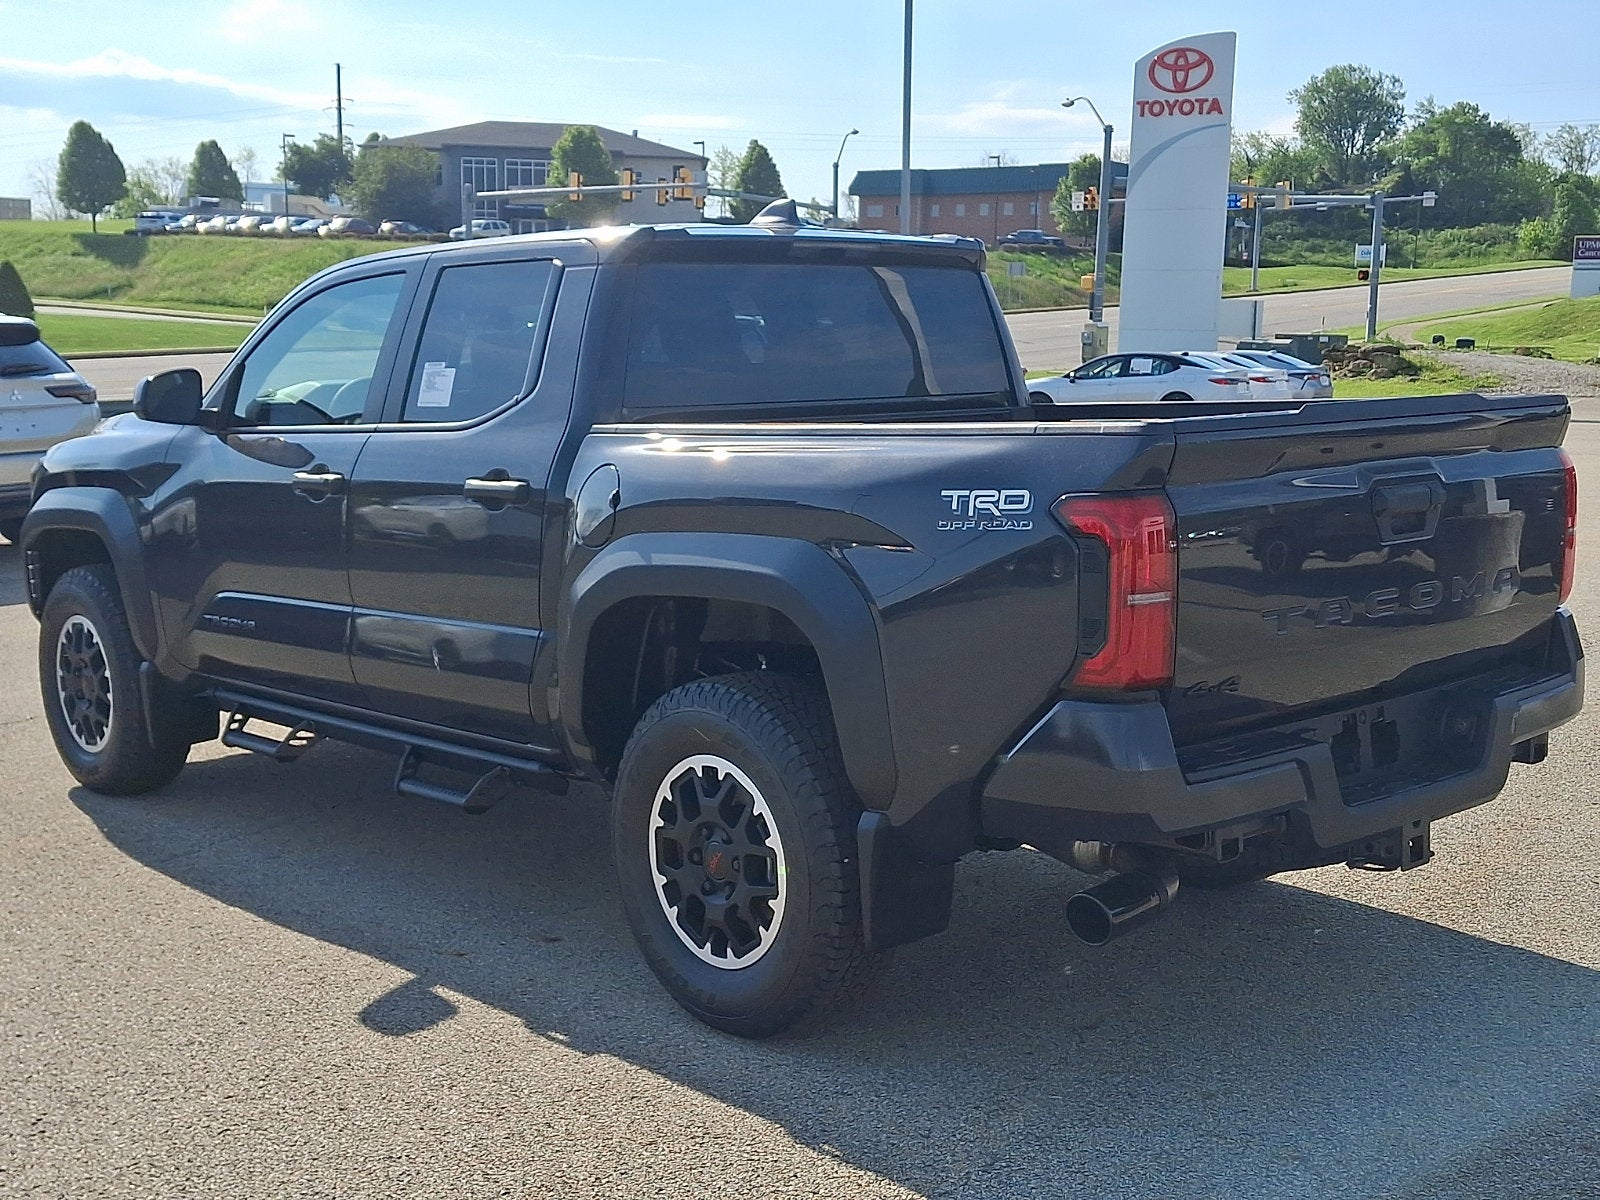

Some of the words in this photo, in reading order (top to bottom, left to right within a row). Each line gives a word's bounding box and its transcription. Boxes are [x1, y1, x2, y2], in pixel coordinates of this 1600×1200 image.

[1136, 97, 1223, 118] TOYOTA
[940, 489, 1031, 517] TRD
[937, 519, 976, 531] OFF
[977, 519, 1034, 531] ROAD
[1261, 566, 1521, 637] TACOMA
[203, 614, 256, 630] TACOMA
